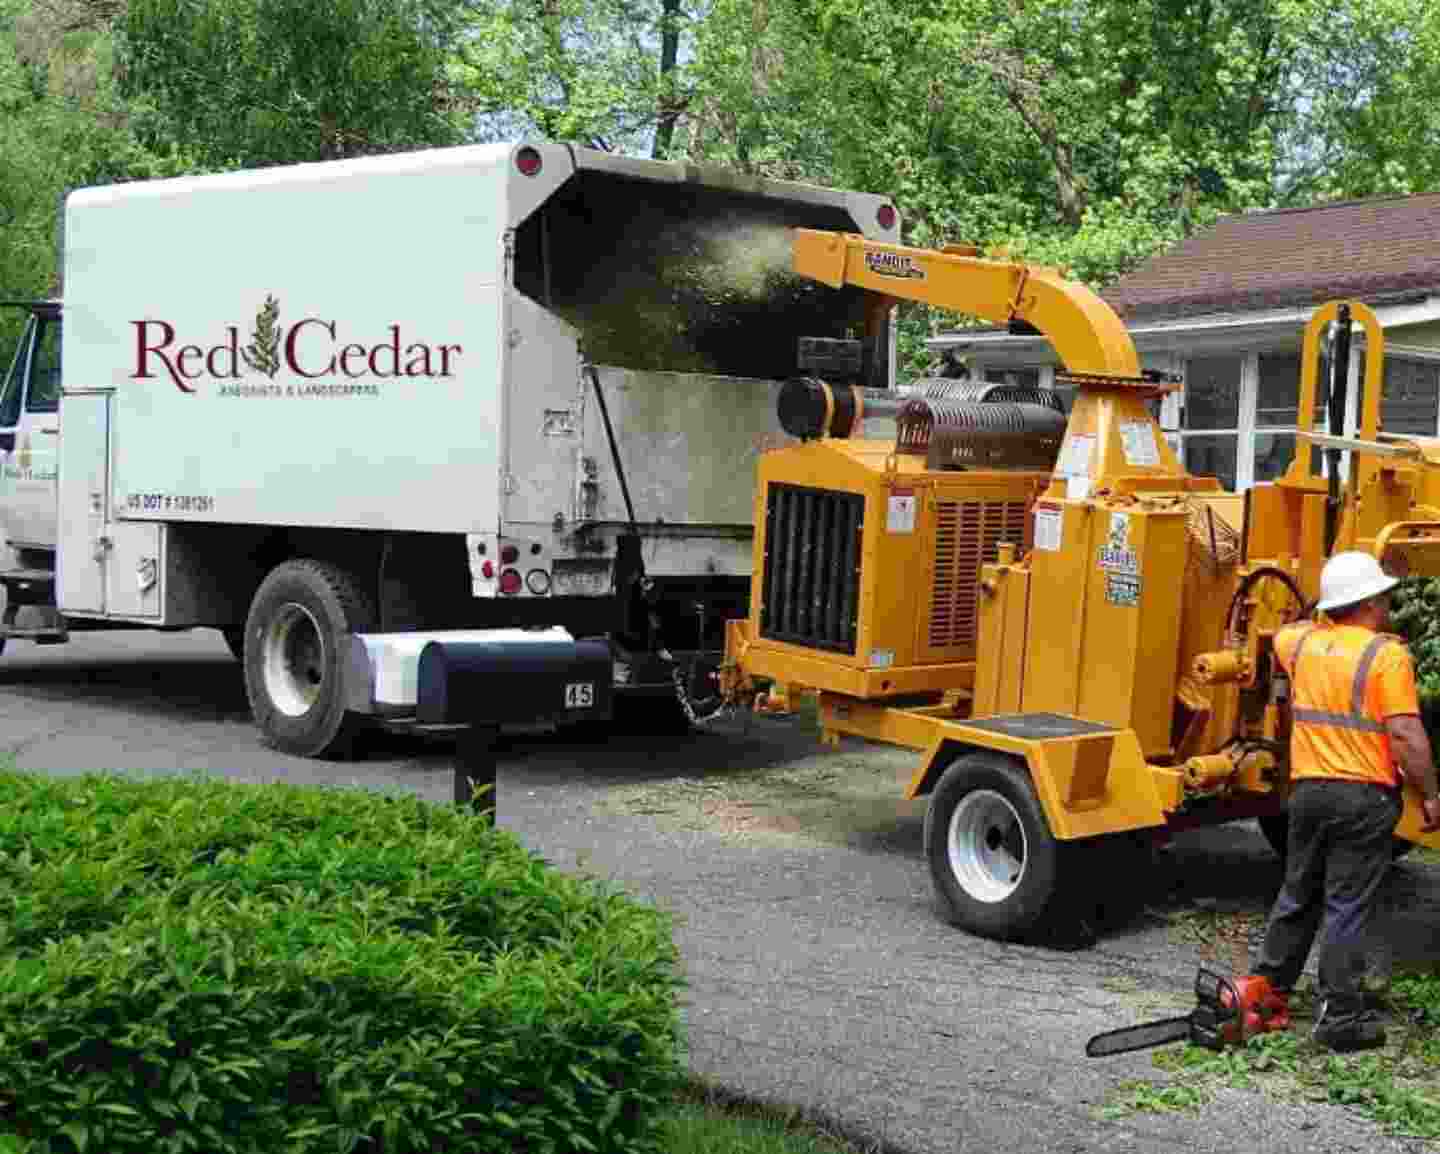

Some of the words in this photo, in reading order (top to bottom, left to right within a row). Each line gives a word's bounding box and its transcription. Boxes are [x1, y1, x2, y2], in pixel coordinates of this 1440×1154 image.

[129, 319, 242, 393] Red
[285, 318, 463, 378] Cedar
[298, 384, 379, 397] LANDSCAPERS
[127, 494, 140, 508] US
[143, 494, 161, 509] DOT
[568, 686, 591, 704] 45
